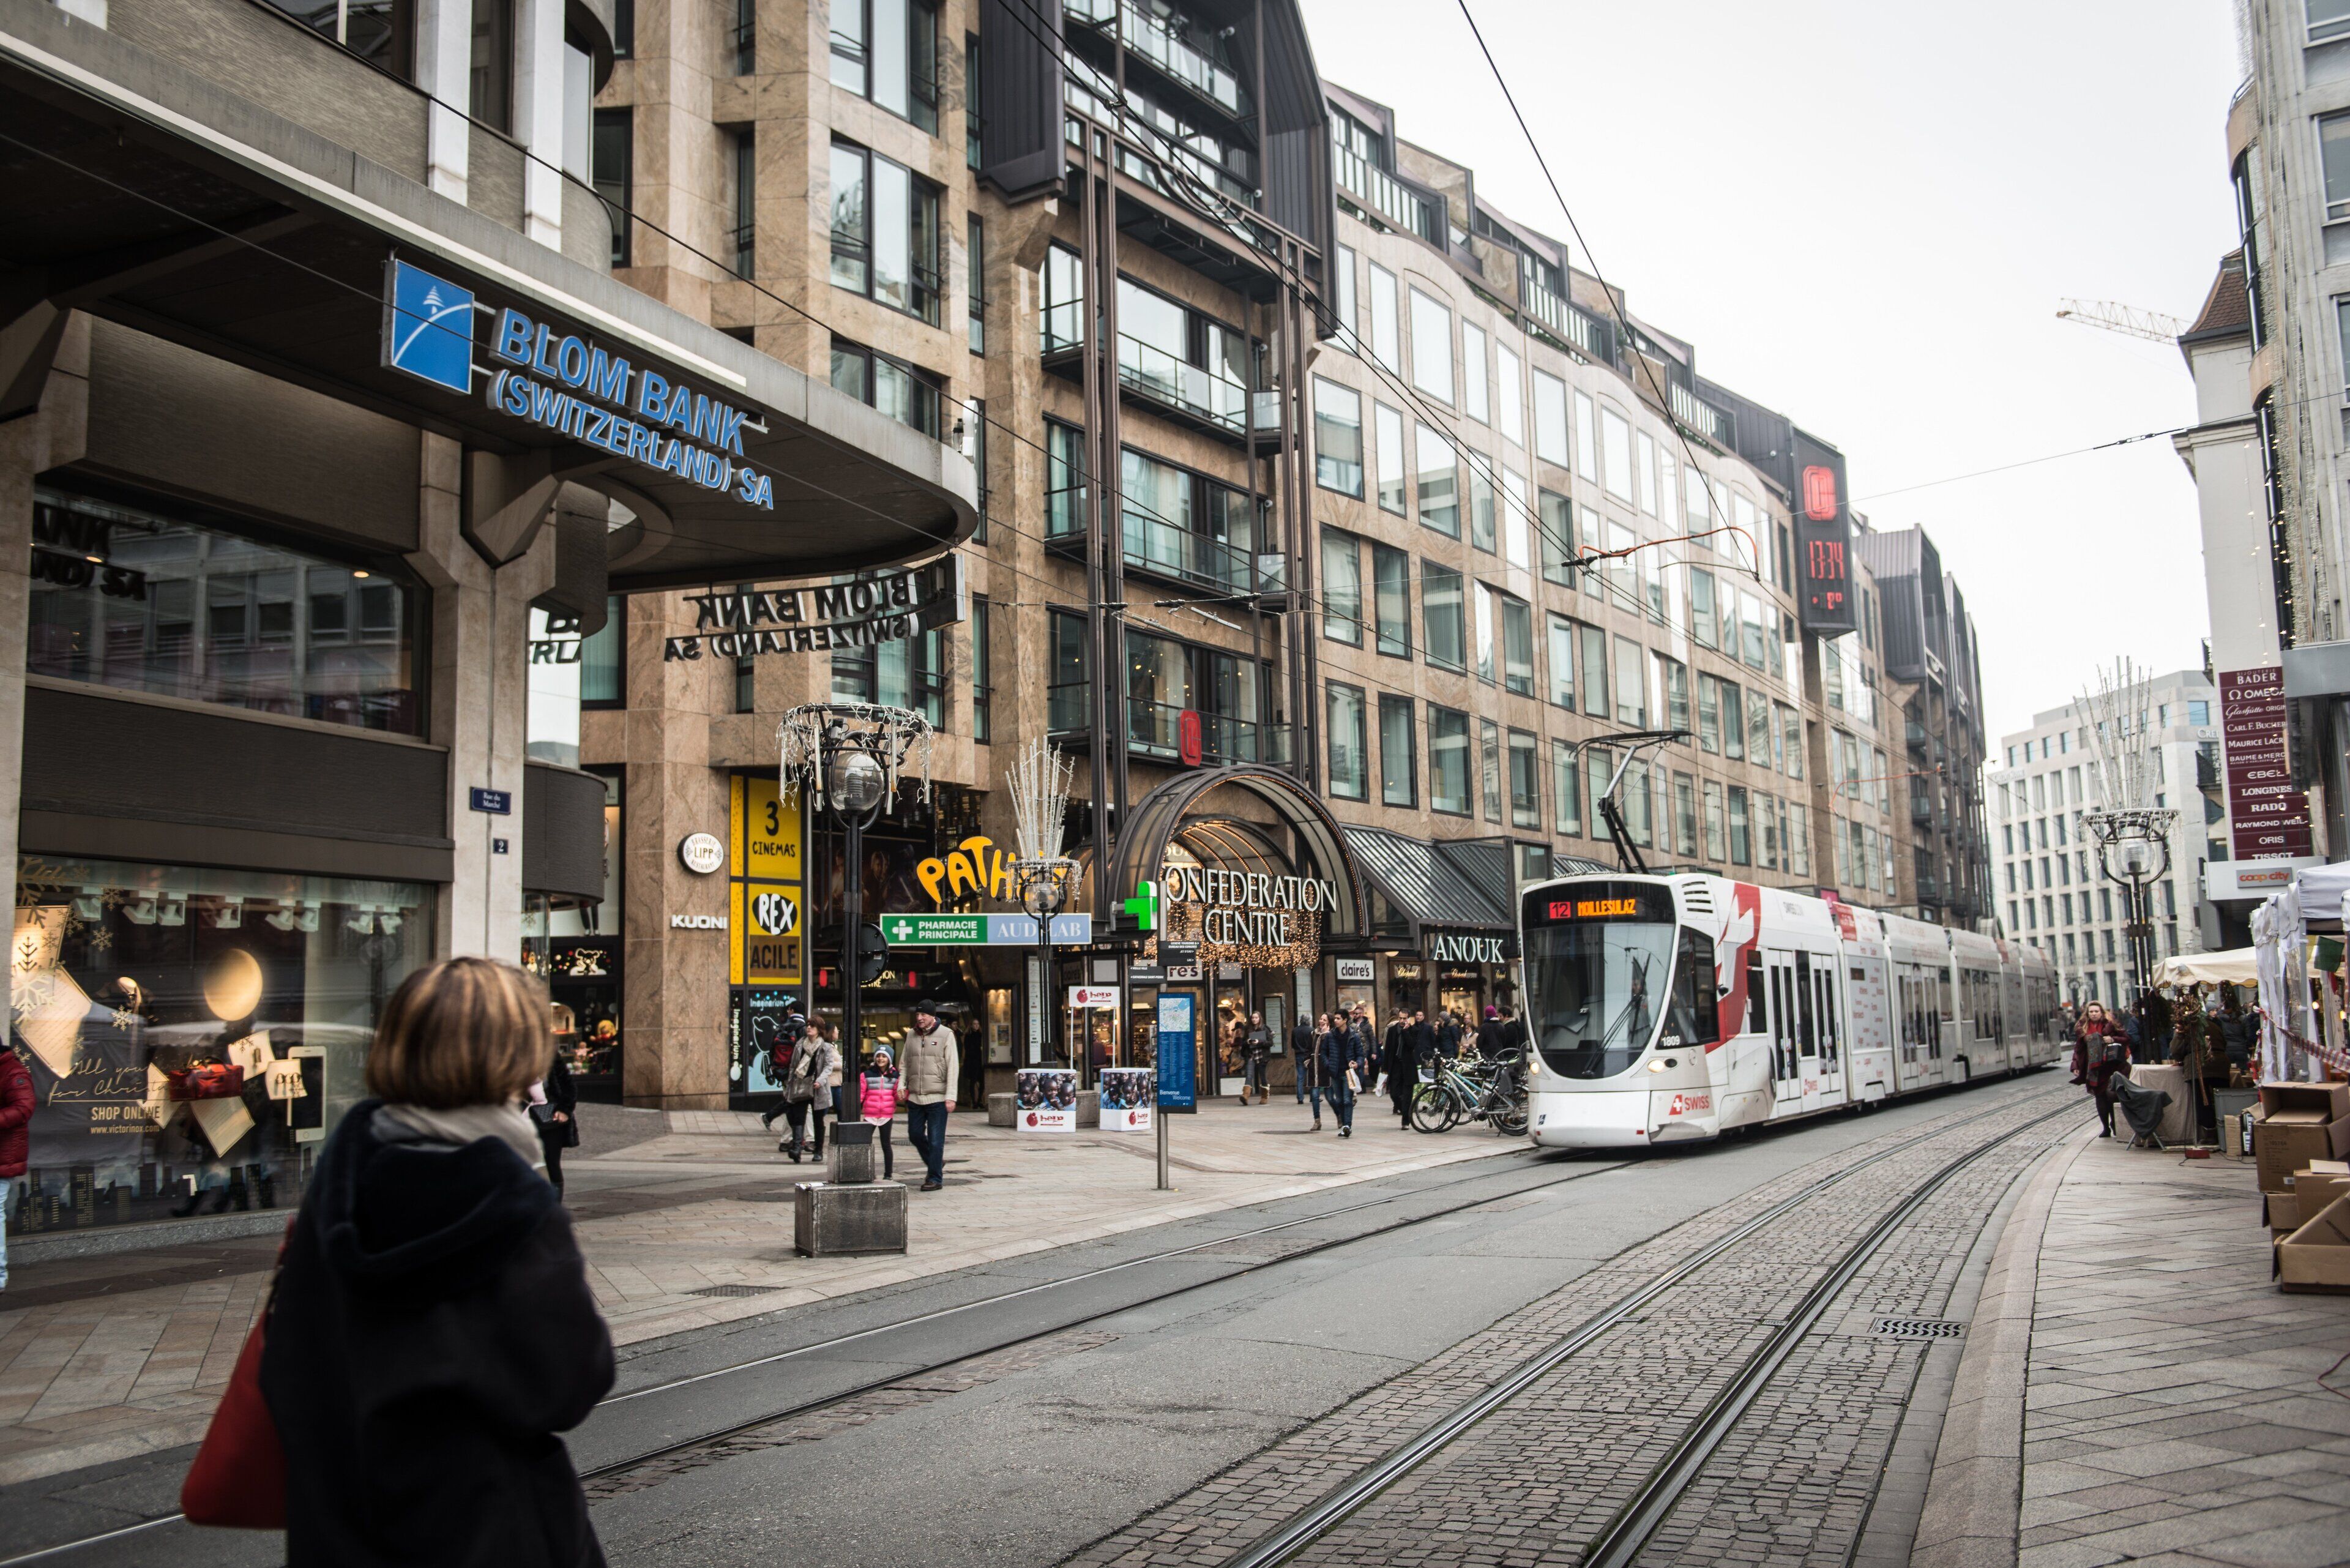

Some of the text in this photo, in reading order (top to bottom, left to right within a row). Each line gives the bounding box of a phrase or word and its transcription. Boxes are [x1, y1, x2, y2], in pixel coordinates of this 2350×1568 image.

[494, 308, 748, 457] BLOM BANK
[496, 369, 773, 510] (SWITZERLAND) SA
[2237, 673, 2277, 684] BADER
[2226, 704, 2263, 719] Glashütte
[2228, 739, 2262, 748] MAURICE
[2242, 785, 2292, 796] LONGINES
[2251, 802, 2287, 812] RADO
[765, 801, 779, 836] 3
[2236, 819, 2280, 829] RAYMOND
[499, 841, 504, 852] 2
[695, 847, 713, 859] LIPP
[753, 842, 795, 857] CINEMAS
[2239, 871, 2289, 883] coop city
[1162, 865, 1337, 913] ONFEDERATION
[759, 893, 794, 935] REX
[1552, 903, 1568, 917] 12
[671, 914, 728, 929] KUONI
[1205, 909, 1291, 946] CENTRE
[919, 930, 977, 939] PRINCIPALE
[1433, 935, 1505, 963] ANOUK
[1341, 962, 1370, 977] claire's
[750, 998, 784, 1011] Imaginarium
[730, 1009, 740, 1059] Imaginarium
[1662, 1036, 1680, 1046] 1809
[1684, 1095, 1709, 1111] SWISS
[92, 1106, 160, 1121] SHOP ONLINE
[91, 1124, 159, 1134] www.victorinox.com
